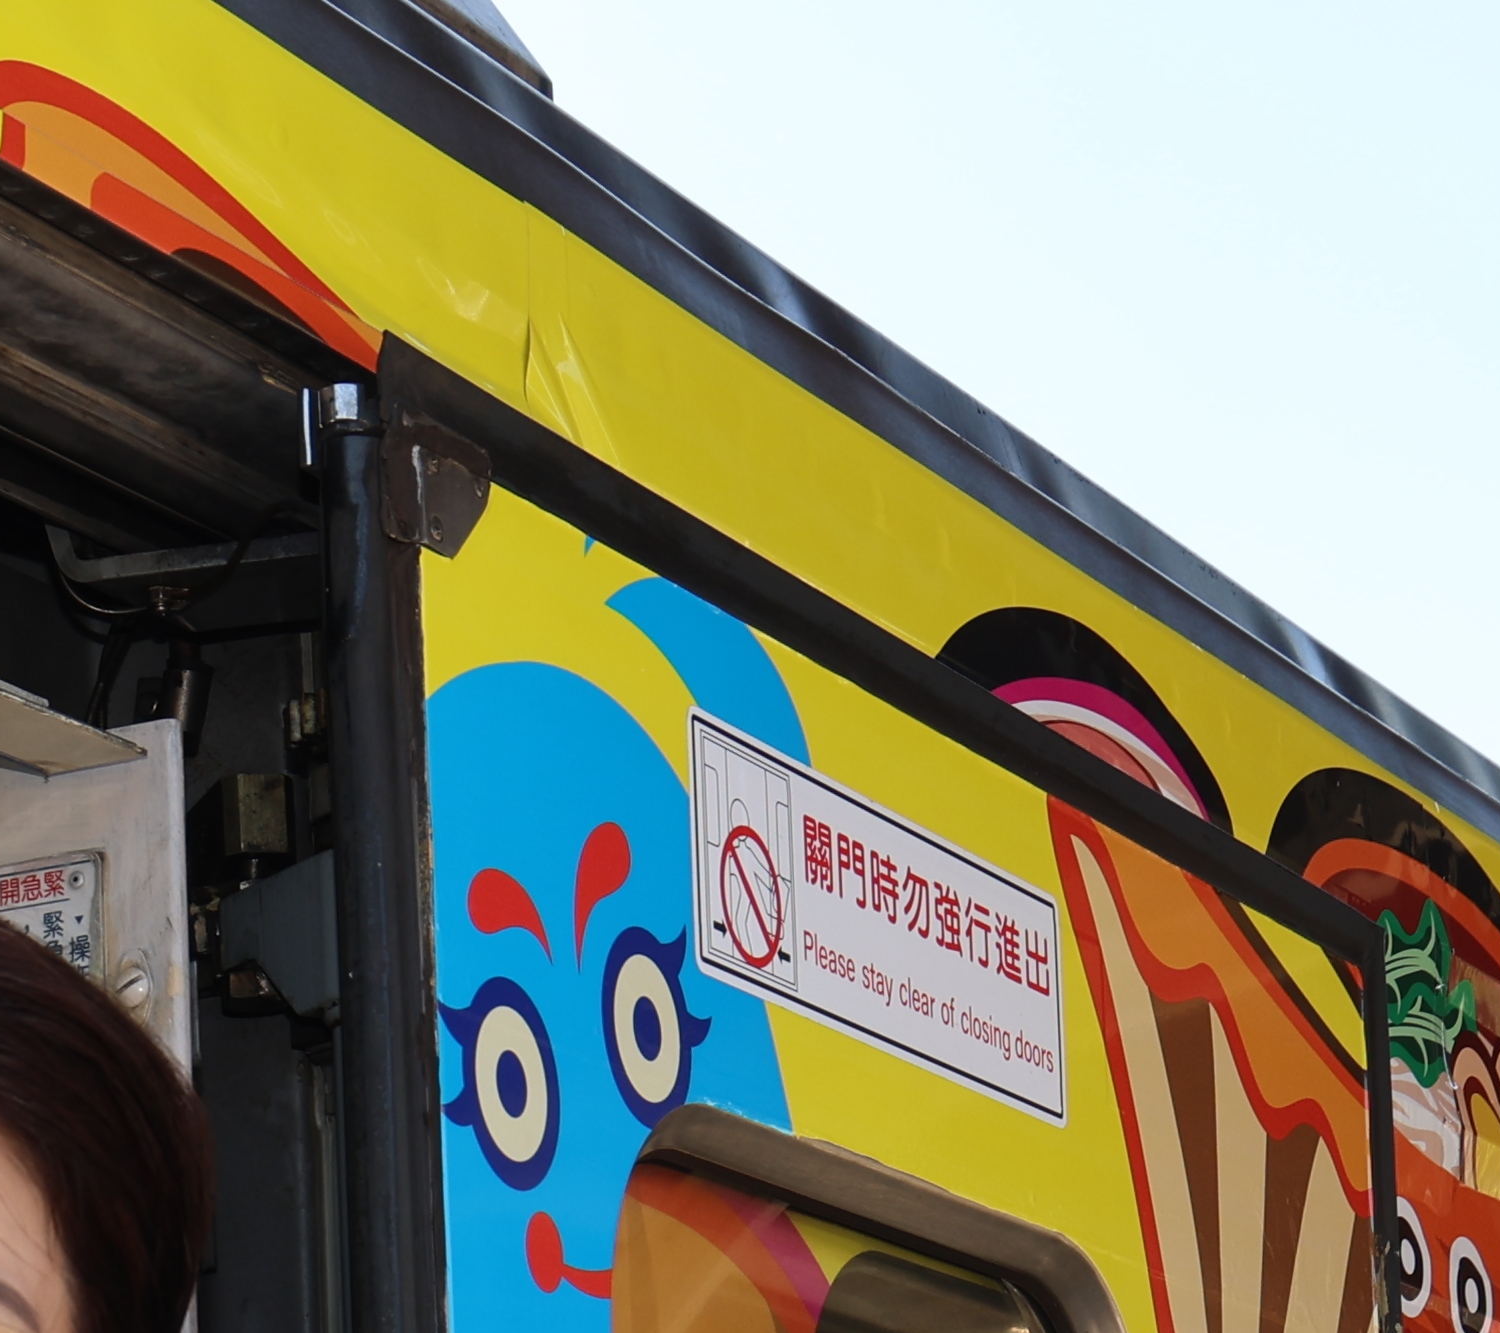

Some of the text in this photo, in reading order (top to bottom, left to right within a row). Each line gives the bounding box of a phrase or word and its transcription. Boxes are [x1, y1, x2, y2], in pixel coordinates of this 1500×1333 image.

[803, 814, 1050, 997] 關門時勿強行進出
[803, 929, 1054, 1073] Please stay clear of closing doors
